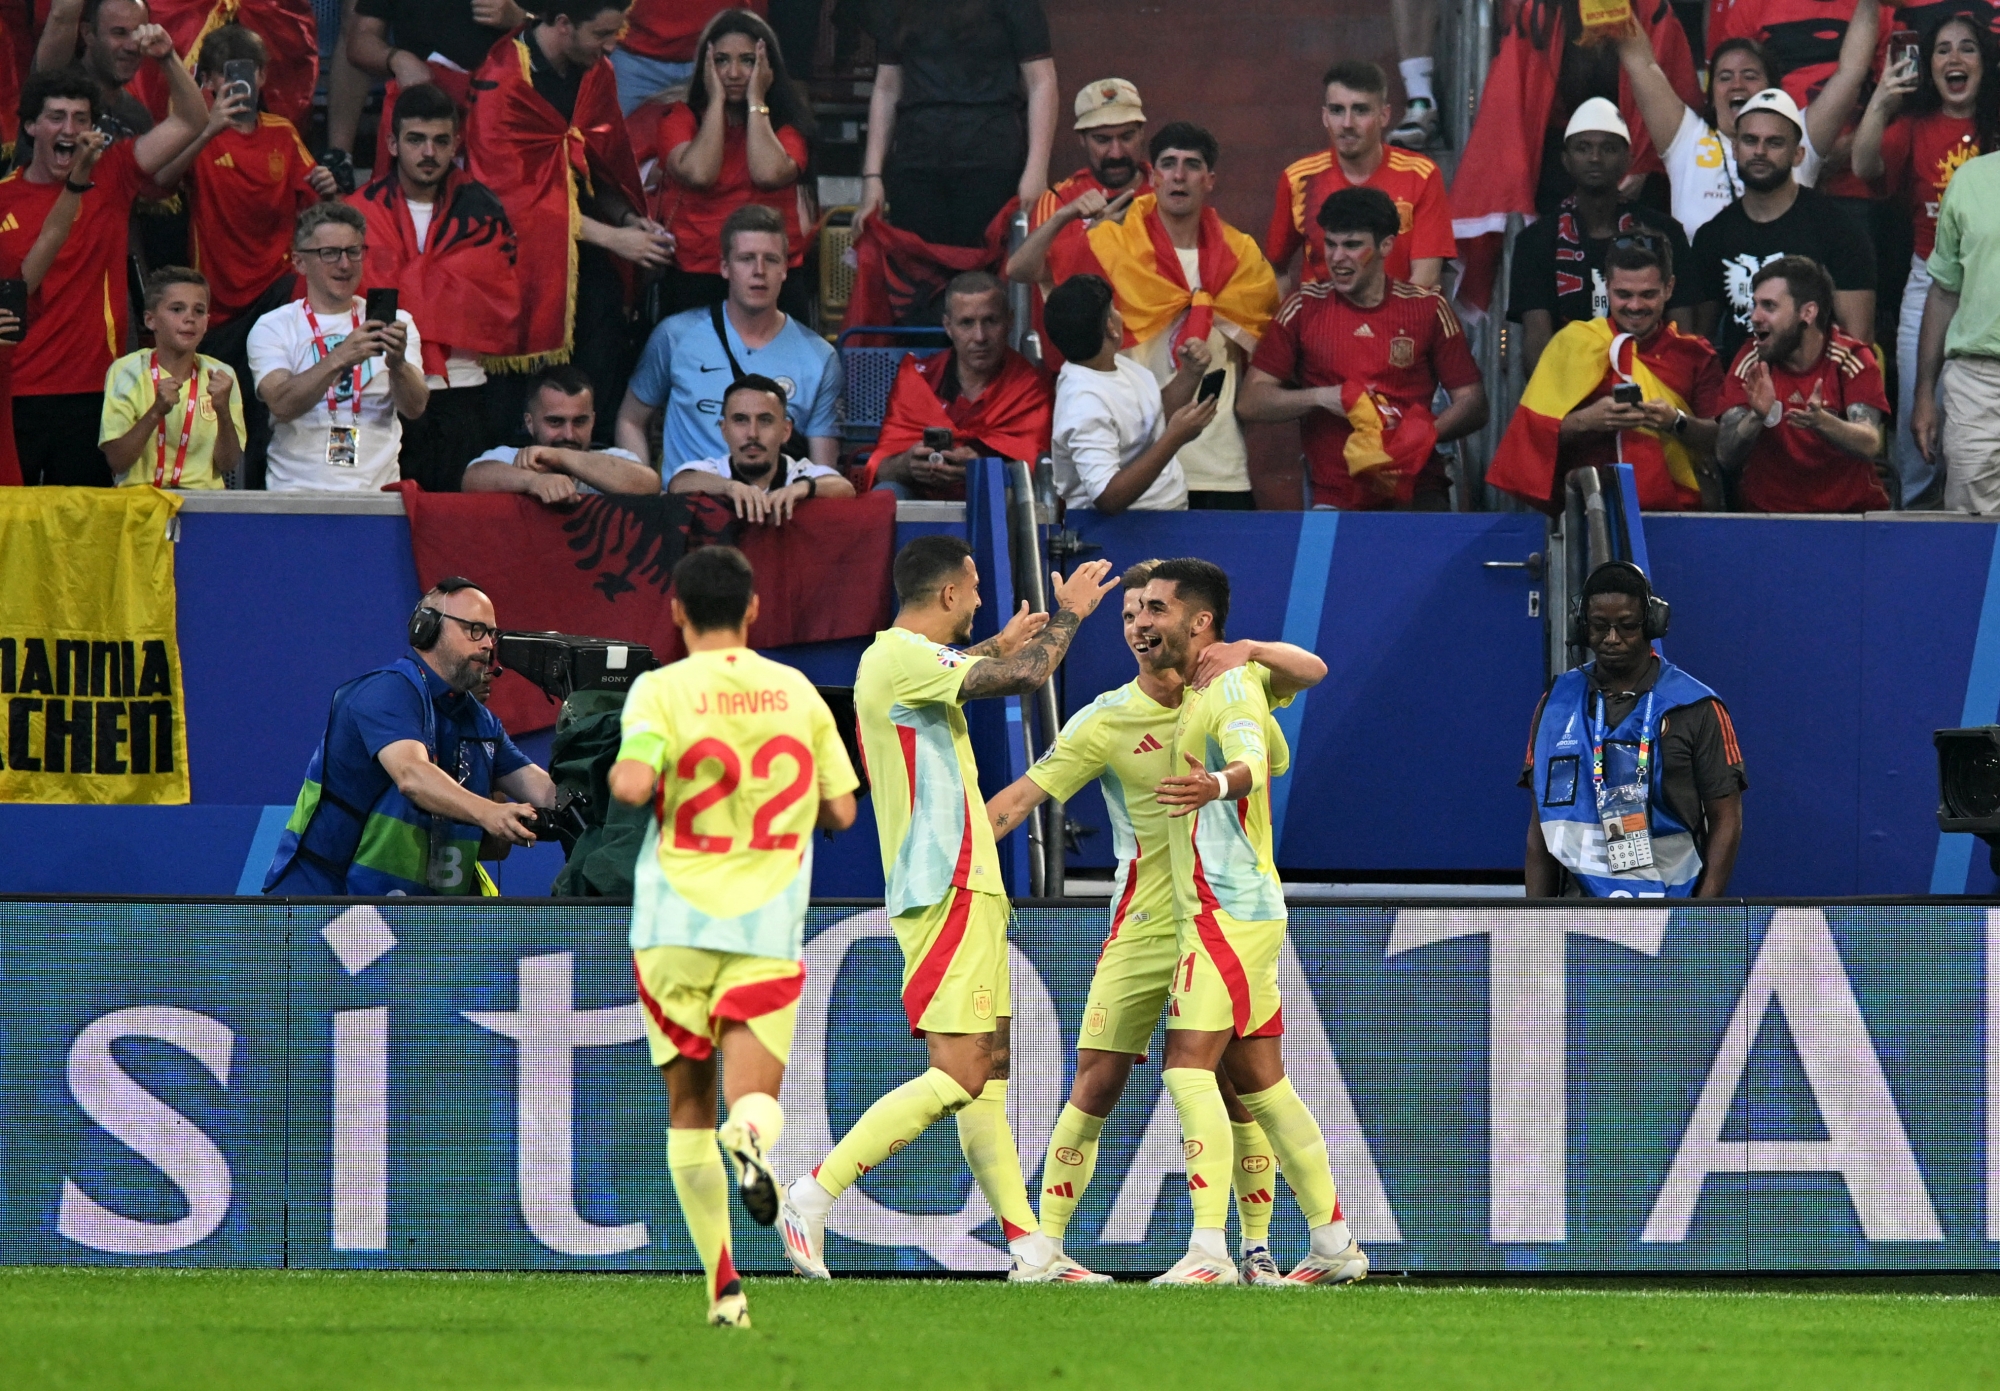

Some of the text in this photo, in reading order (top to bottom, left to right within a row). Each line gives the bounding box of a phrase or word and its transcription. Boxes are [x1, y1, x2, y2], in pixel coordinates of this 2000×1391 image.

[0, 697, 174, 775] CHEN
[674, 735, 814, 854] 22
[56, 905, 2000, 1274] sit QATA
